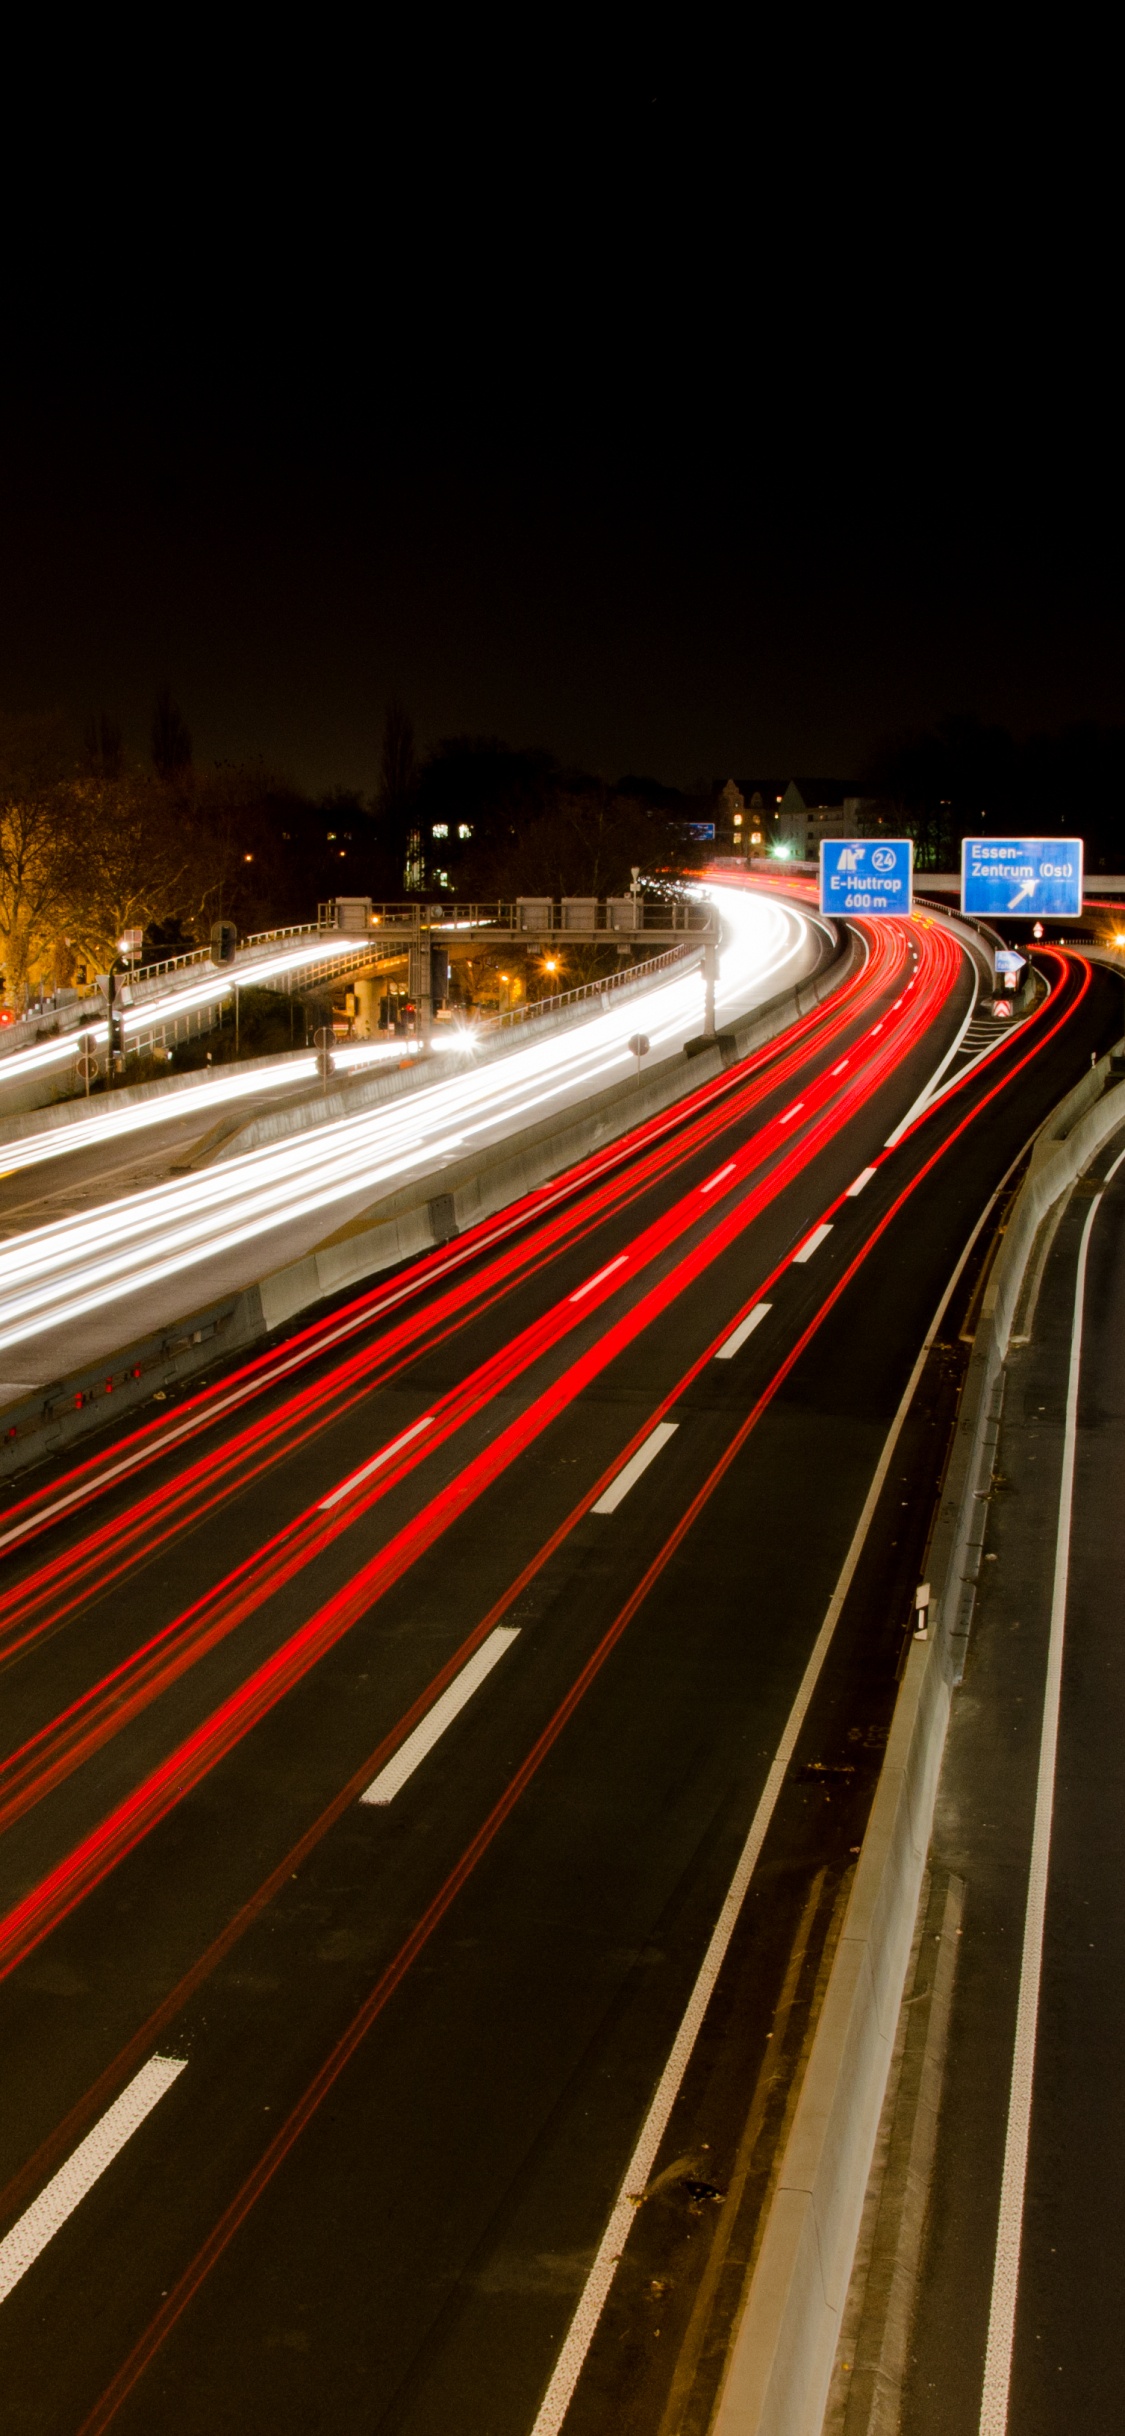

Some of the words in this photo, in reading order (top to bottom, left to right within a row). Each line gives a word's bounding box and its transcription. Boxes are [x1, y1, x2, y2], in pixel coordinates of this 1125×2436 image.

[971, 845, 1022, 859] Essen-
[875, 852, 893, 867] 24
[971, 863, 1033, 877] Zentrum
[1039, 863, 1073, 877] (Ost)
[830, 876, 901, 893] E-Huttrop
[845, 893, 871, 907] 600
[873, 896, 887, 907] m
